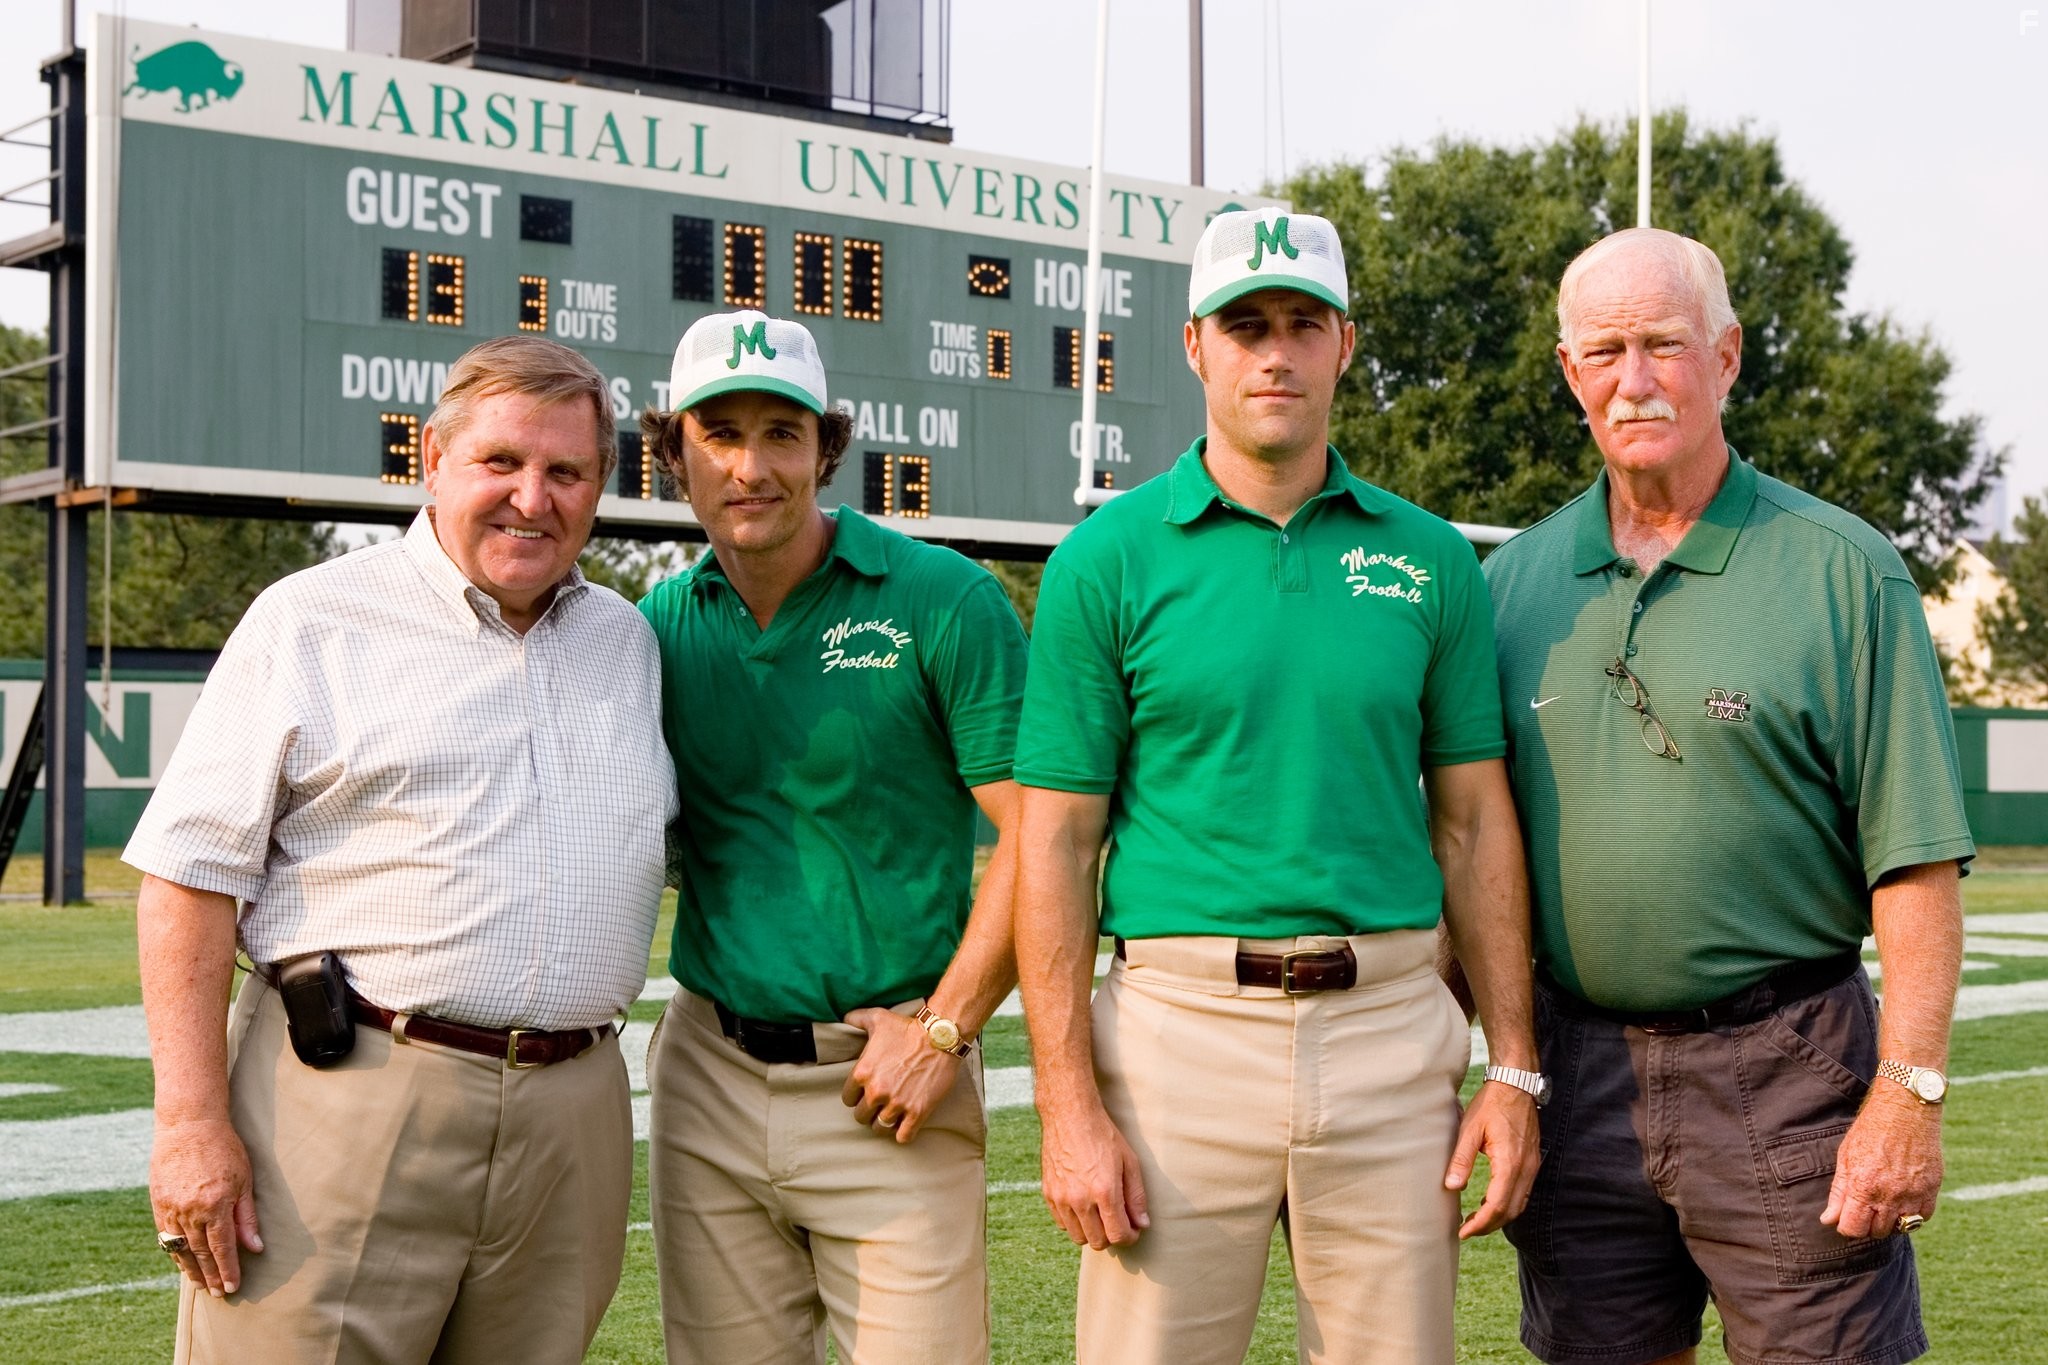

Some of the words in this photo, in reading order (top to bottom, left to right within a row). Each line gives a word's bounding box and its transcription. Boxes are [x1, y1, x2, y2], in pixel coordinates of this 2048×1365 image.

[299, 63, 730, 180] MARSHALL
[797, 138, 1183, 246] UNIVERSTY
[346, 166, 502, 239] GUEST
[1247, 216, 1299, 270] M
[407, 251, 465, 327] 13
[518, 275, 548, 332] 3
[561, 279, 618, 313] TIME
[1034, 258, 1133, 319] HOME
[555, 309, 618, 343] OUTS
[726, 321, 776, 369] M
[929, 320, 978, 351] TIME
[929, 348, 982, 379] OUTS
[380, 412, 419, 485] 3
[918, 406, 959, 449] ON
[884, 453, 930, 519] 13
[1340, 546, 1432, 586] Marshall
[1345, 575, 1423, 604] Football
[822, 617, 912, 649] Marshall
[820, 648, 900, 674] Football
[1709, 700, 1747, 710] MARSHALL
